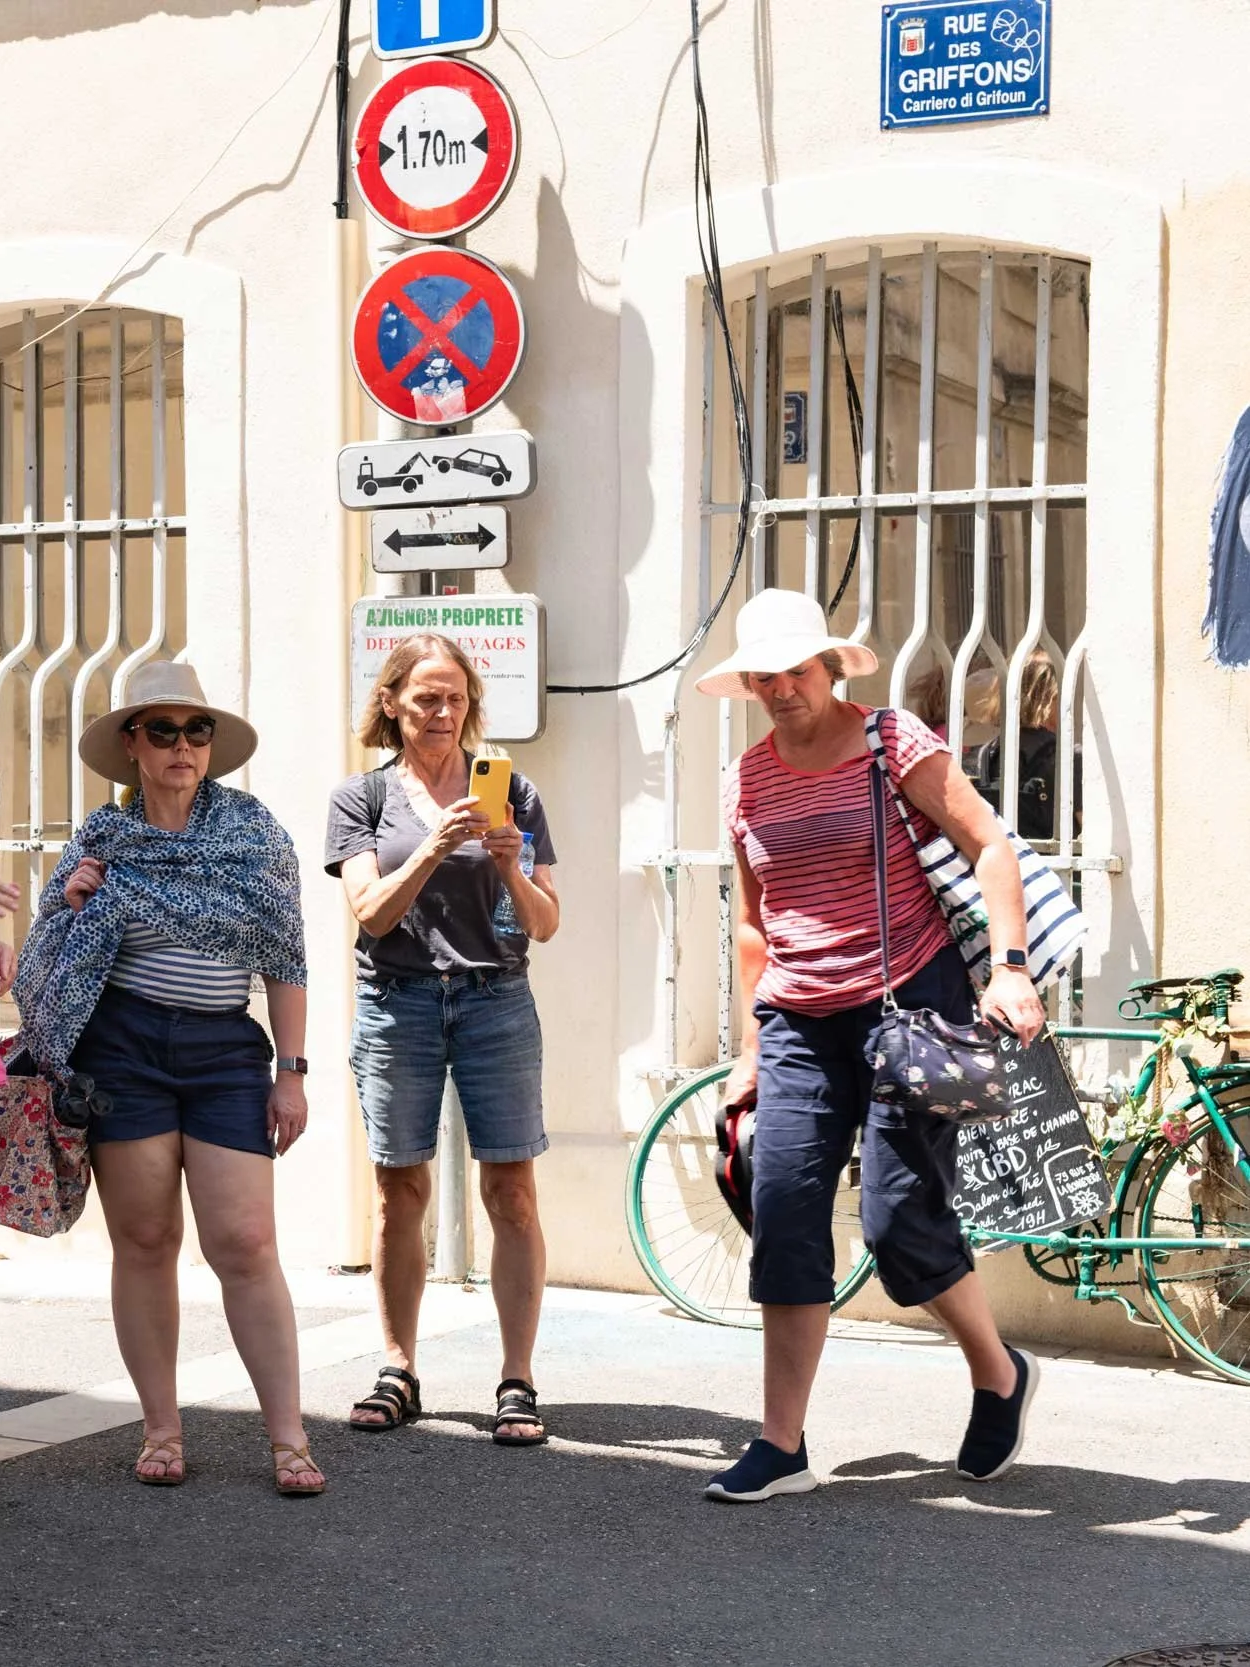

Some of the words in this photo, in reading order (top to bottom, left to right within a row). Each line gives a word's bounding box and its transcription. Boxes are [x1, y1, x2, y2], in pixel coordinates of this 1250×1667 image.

[944, 13, 987, 35] RUE
[948, 42, 981, 58] DES
[899, 58, 1031, 93] GRIFFONS
[903, 95, 957, 113] Carriero
[961, 92, 972, 107] di
[976, 89, 1026, 106] Grifoun
[442, 607, 524, 626] PROPRETE
[456, 637, 526, 650] UVAGES
[1009, 1077, 1042, 1098] RAC
[996, 1133, 1021, 1150] BASE
[1022, 1126, 1038, 1140] DE
[981, 1146, 1027, 1181] CBD
[1069, 1166, 1086, 1178] RUE
[953, 1193, 1000, 1221] Salon
[1002, 1183, 1017, 1199] de
